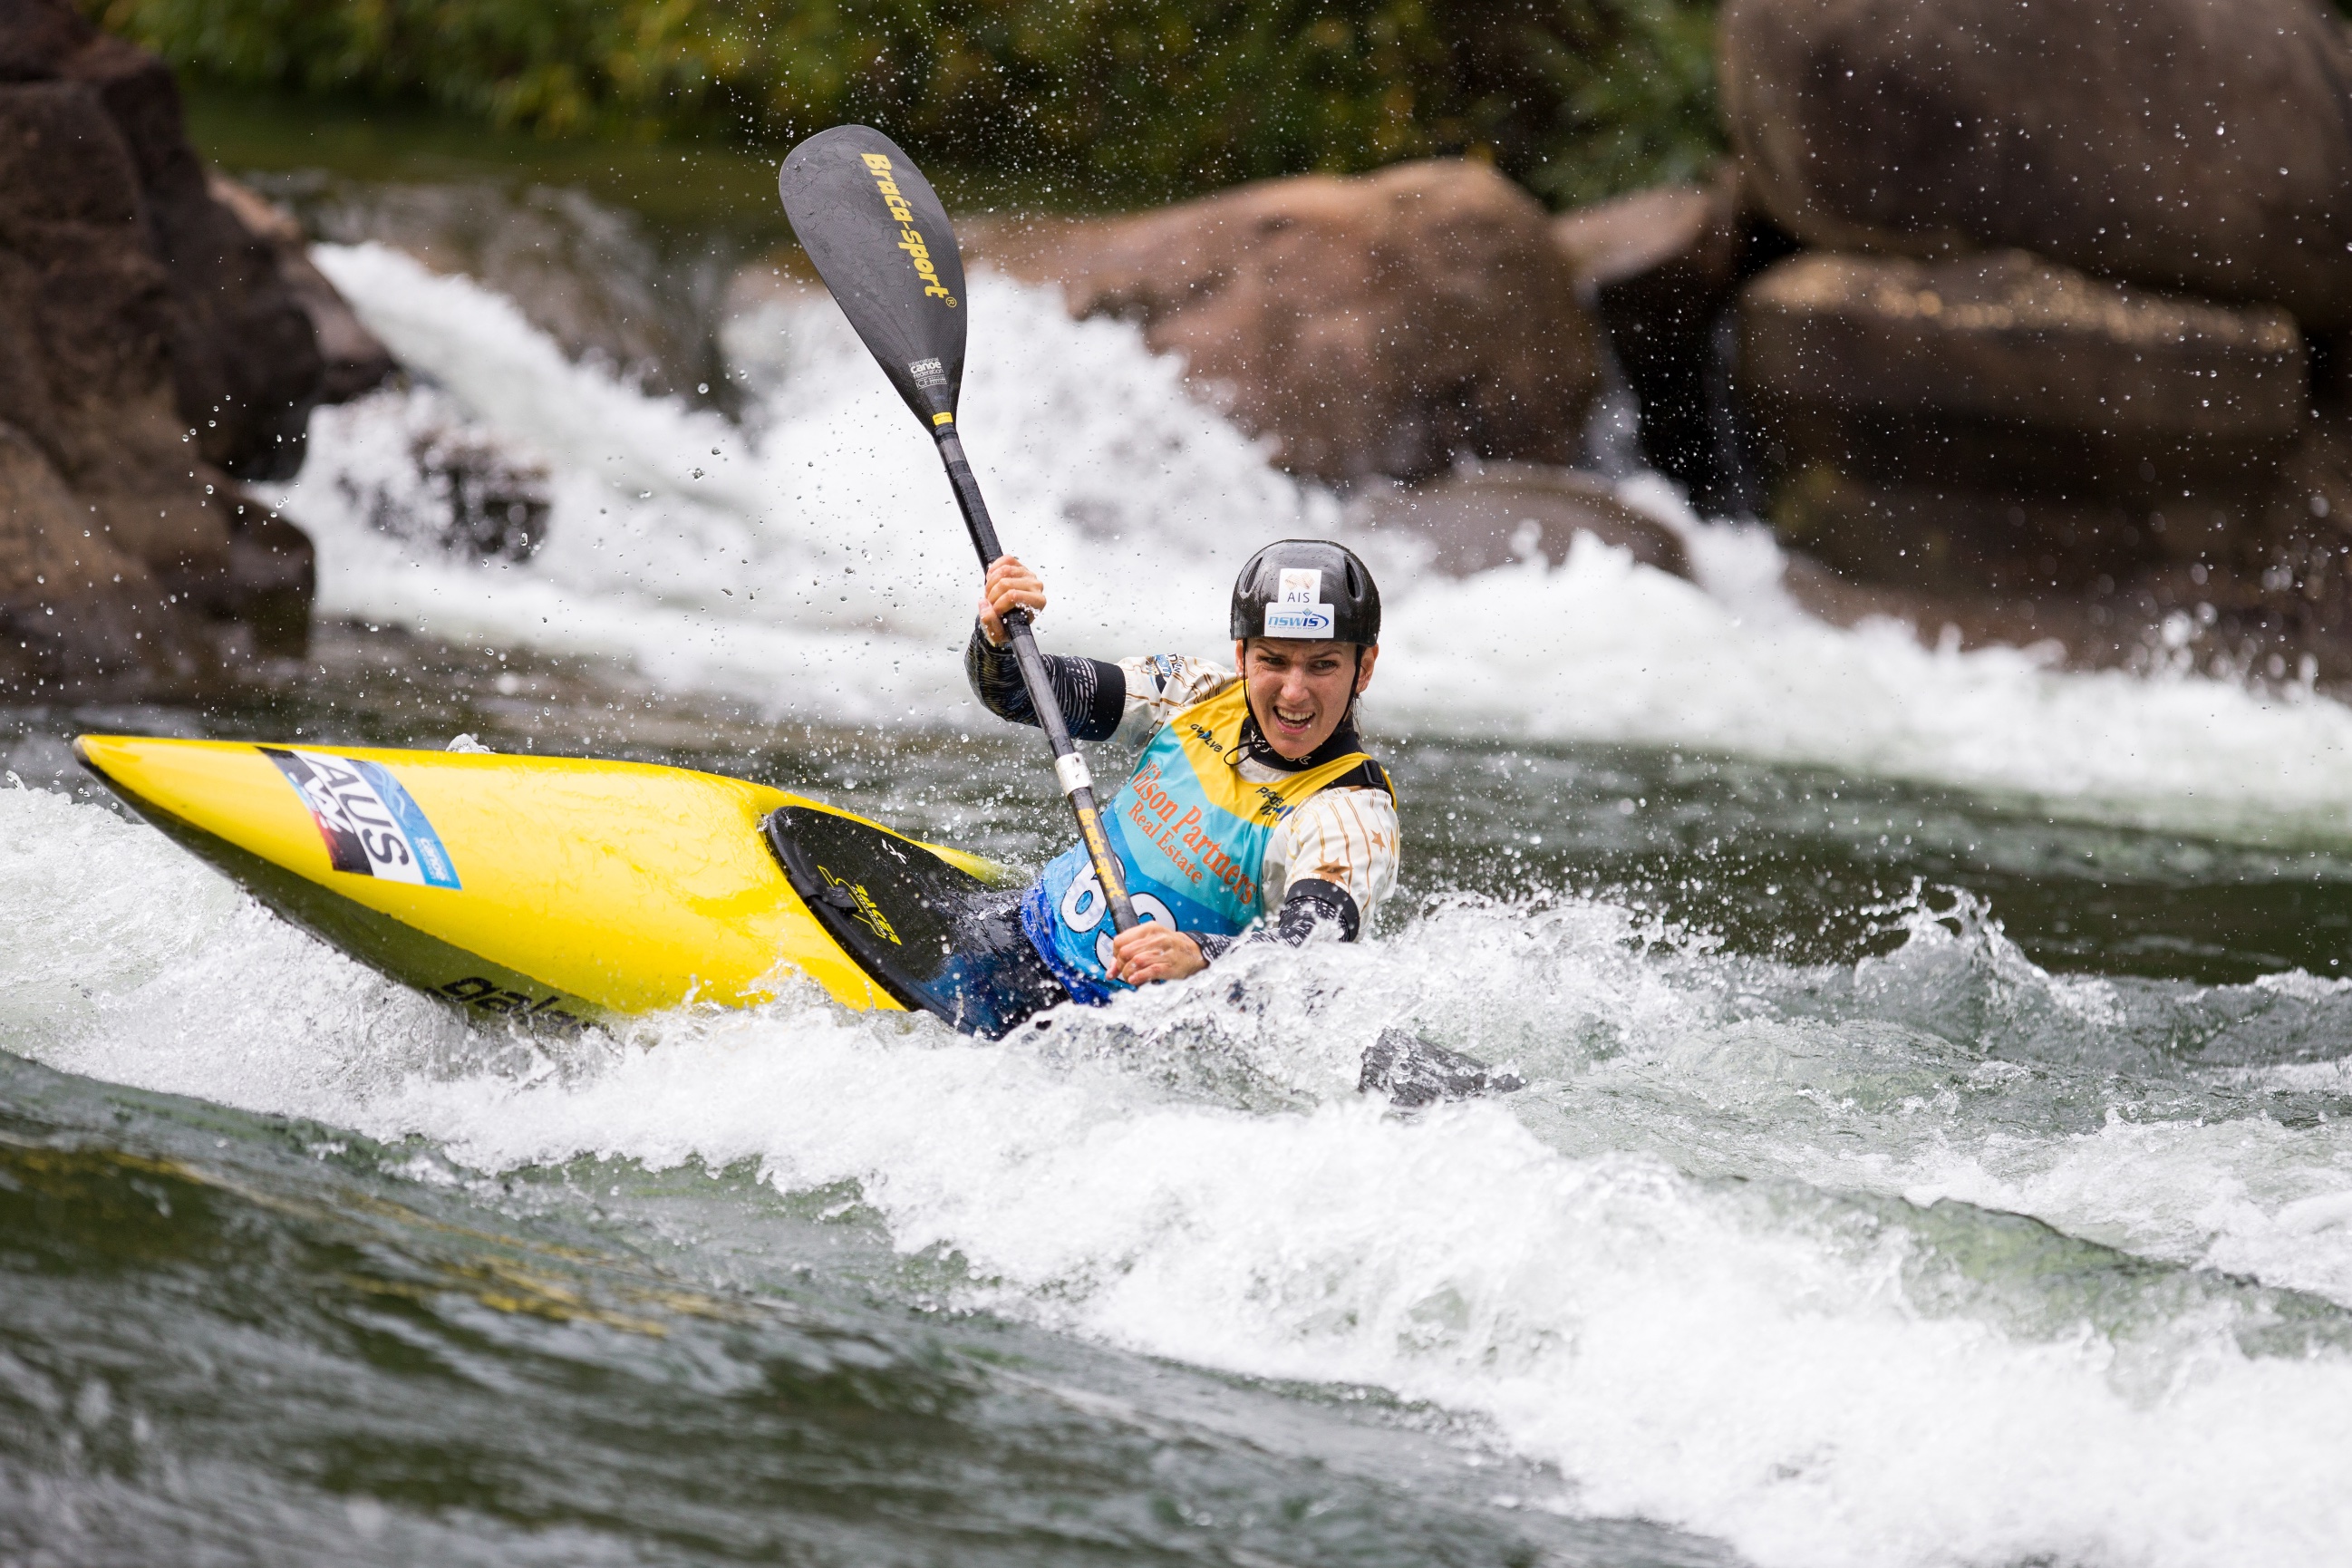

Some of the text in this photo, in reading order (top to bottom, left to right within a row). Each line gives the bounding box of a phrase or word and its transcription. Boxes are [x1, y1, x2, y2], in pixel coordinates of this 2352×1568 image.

[910, 361, 942, 373] canoe
[913, 368, 944, 380] federation
[1287, 592, 1311, 604] AIS
[306, 758, 410, 866] AUS
[1128, 799, 1203, 884] Real Estate
[1171, 805, 1257, 905] Partners
